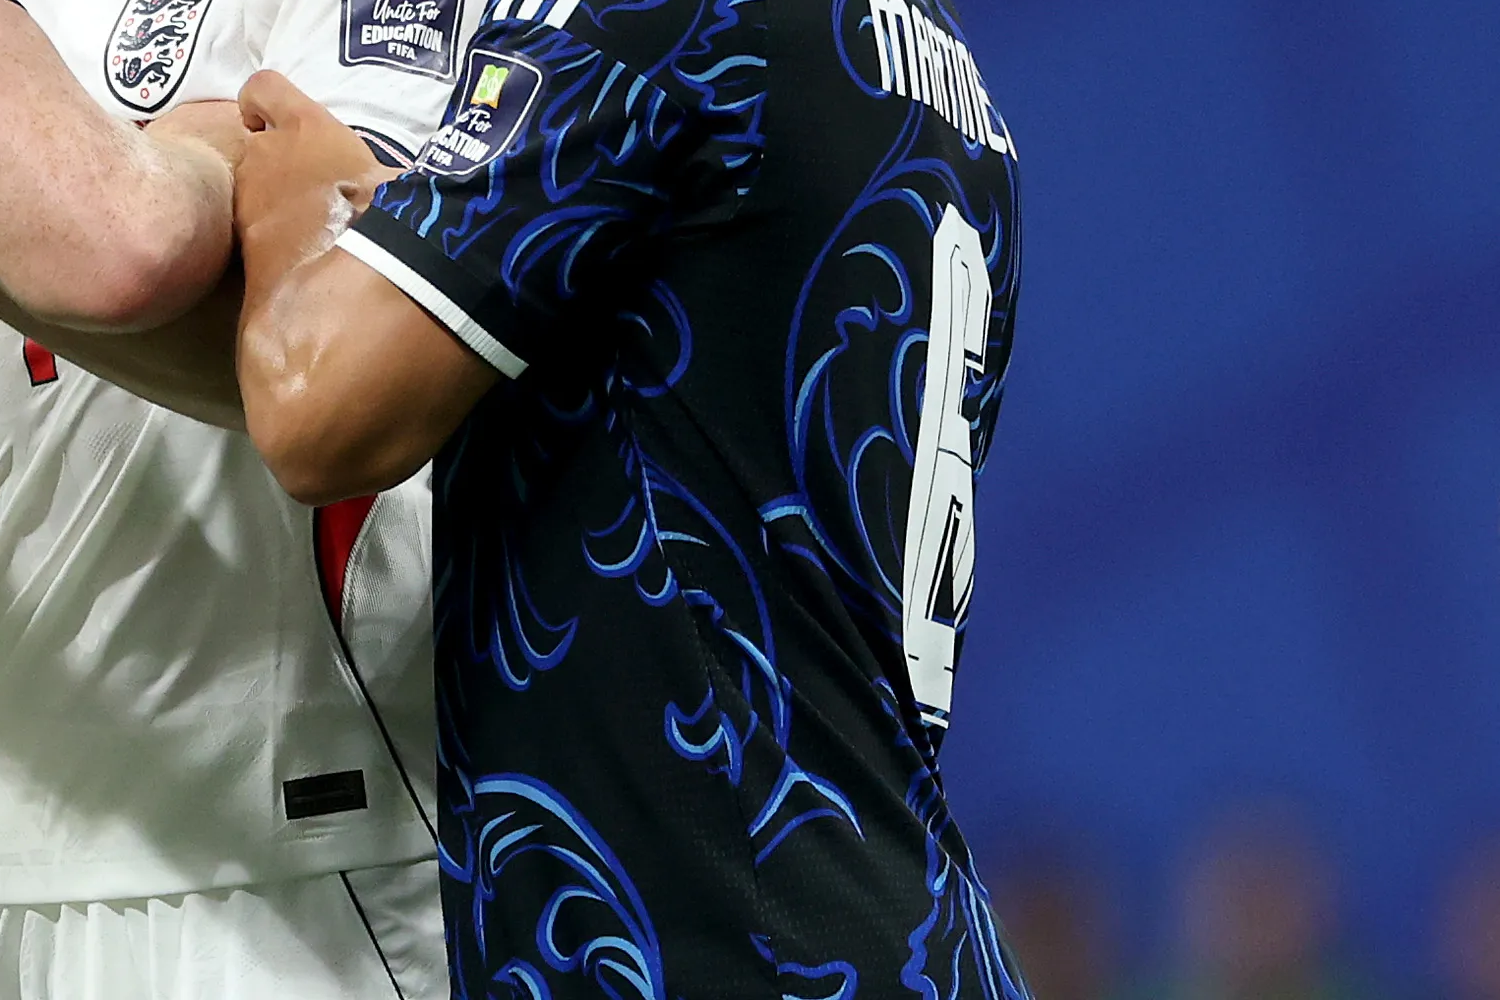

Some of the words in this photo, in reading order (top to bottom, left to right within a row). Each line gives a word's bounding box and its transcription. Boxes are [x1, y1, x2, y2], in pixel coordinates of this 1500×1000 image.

[416, 1, 441, 22] For
[361, 23, 443, 53] EDUCATION
[388, 42, 417, 60] FIFA
[470, 109, 492, 133] For
[426, 145, 453, 167] FIFA
